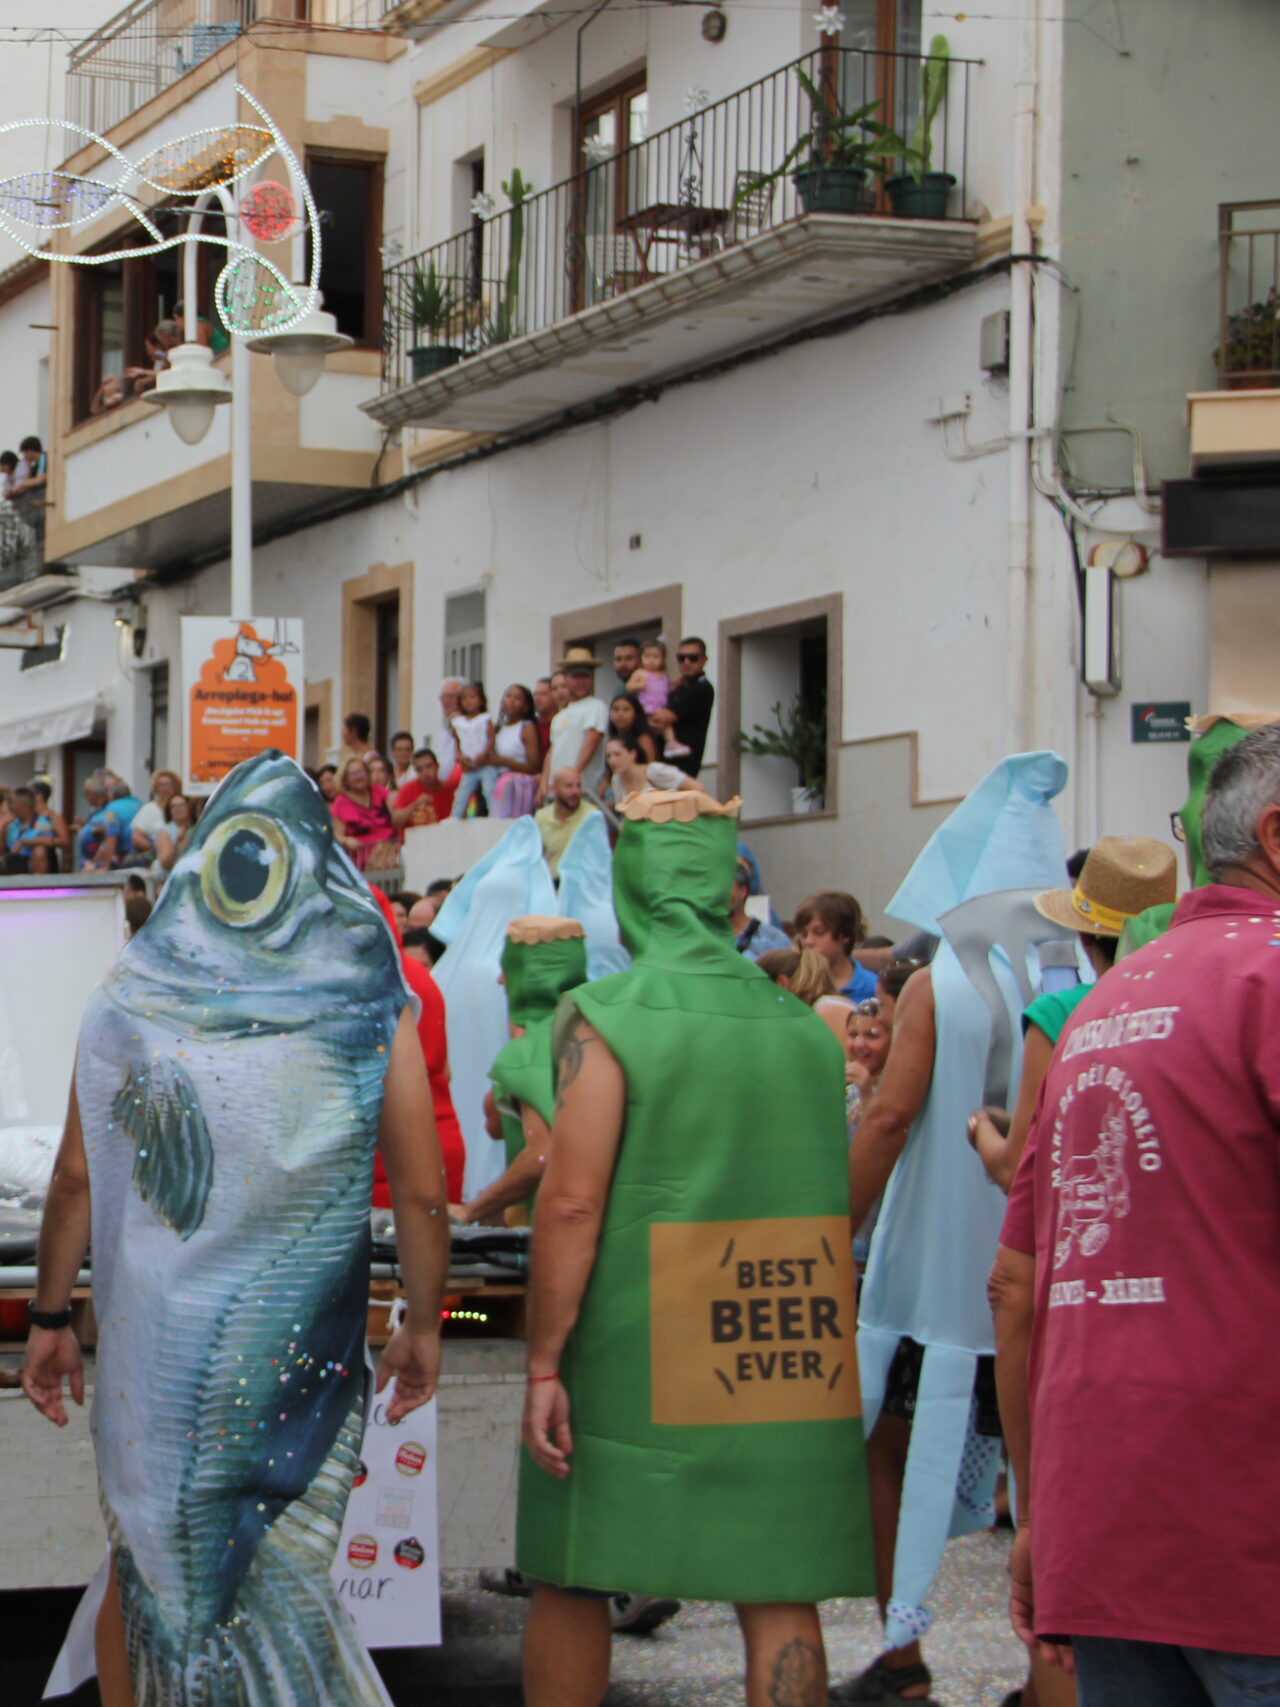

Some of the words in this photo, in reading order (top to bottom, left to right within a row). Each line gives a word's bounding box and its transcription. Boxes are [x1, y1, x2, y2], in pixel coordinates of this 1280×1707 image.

[1118, 1080, 1162, 1171] LORETO
[737, 1258, 818, 1289] BEST
[711, 1296, 843, 1343] BEER
[736, 1350, 825, 1381] EVER
